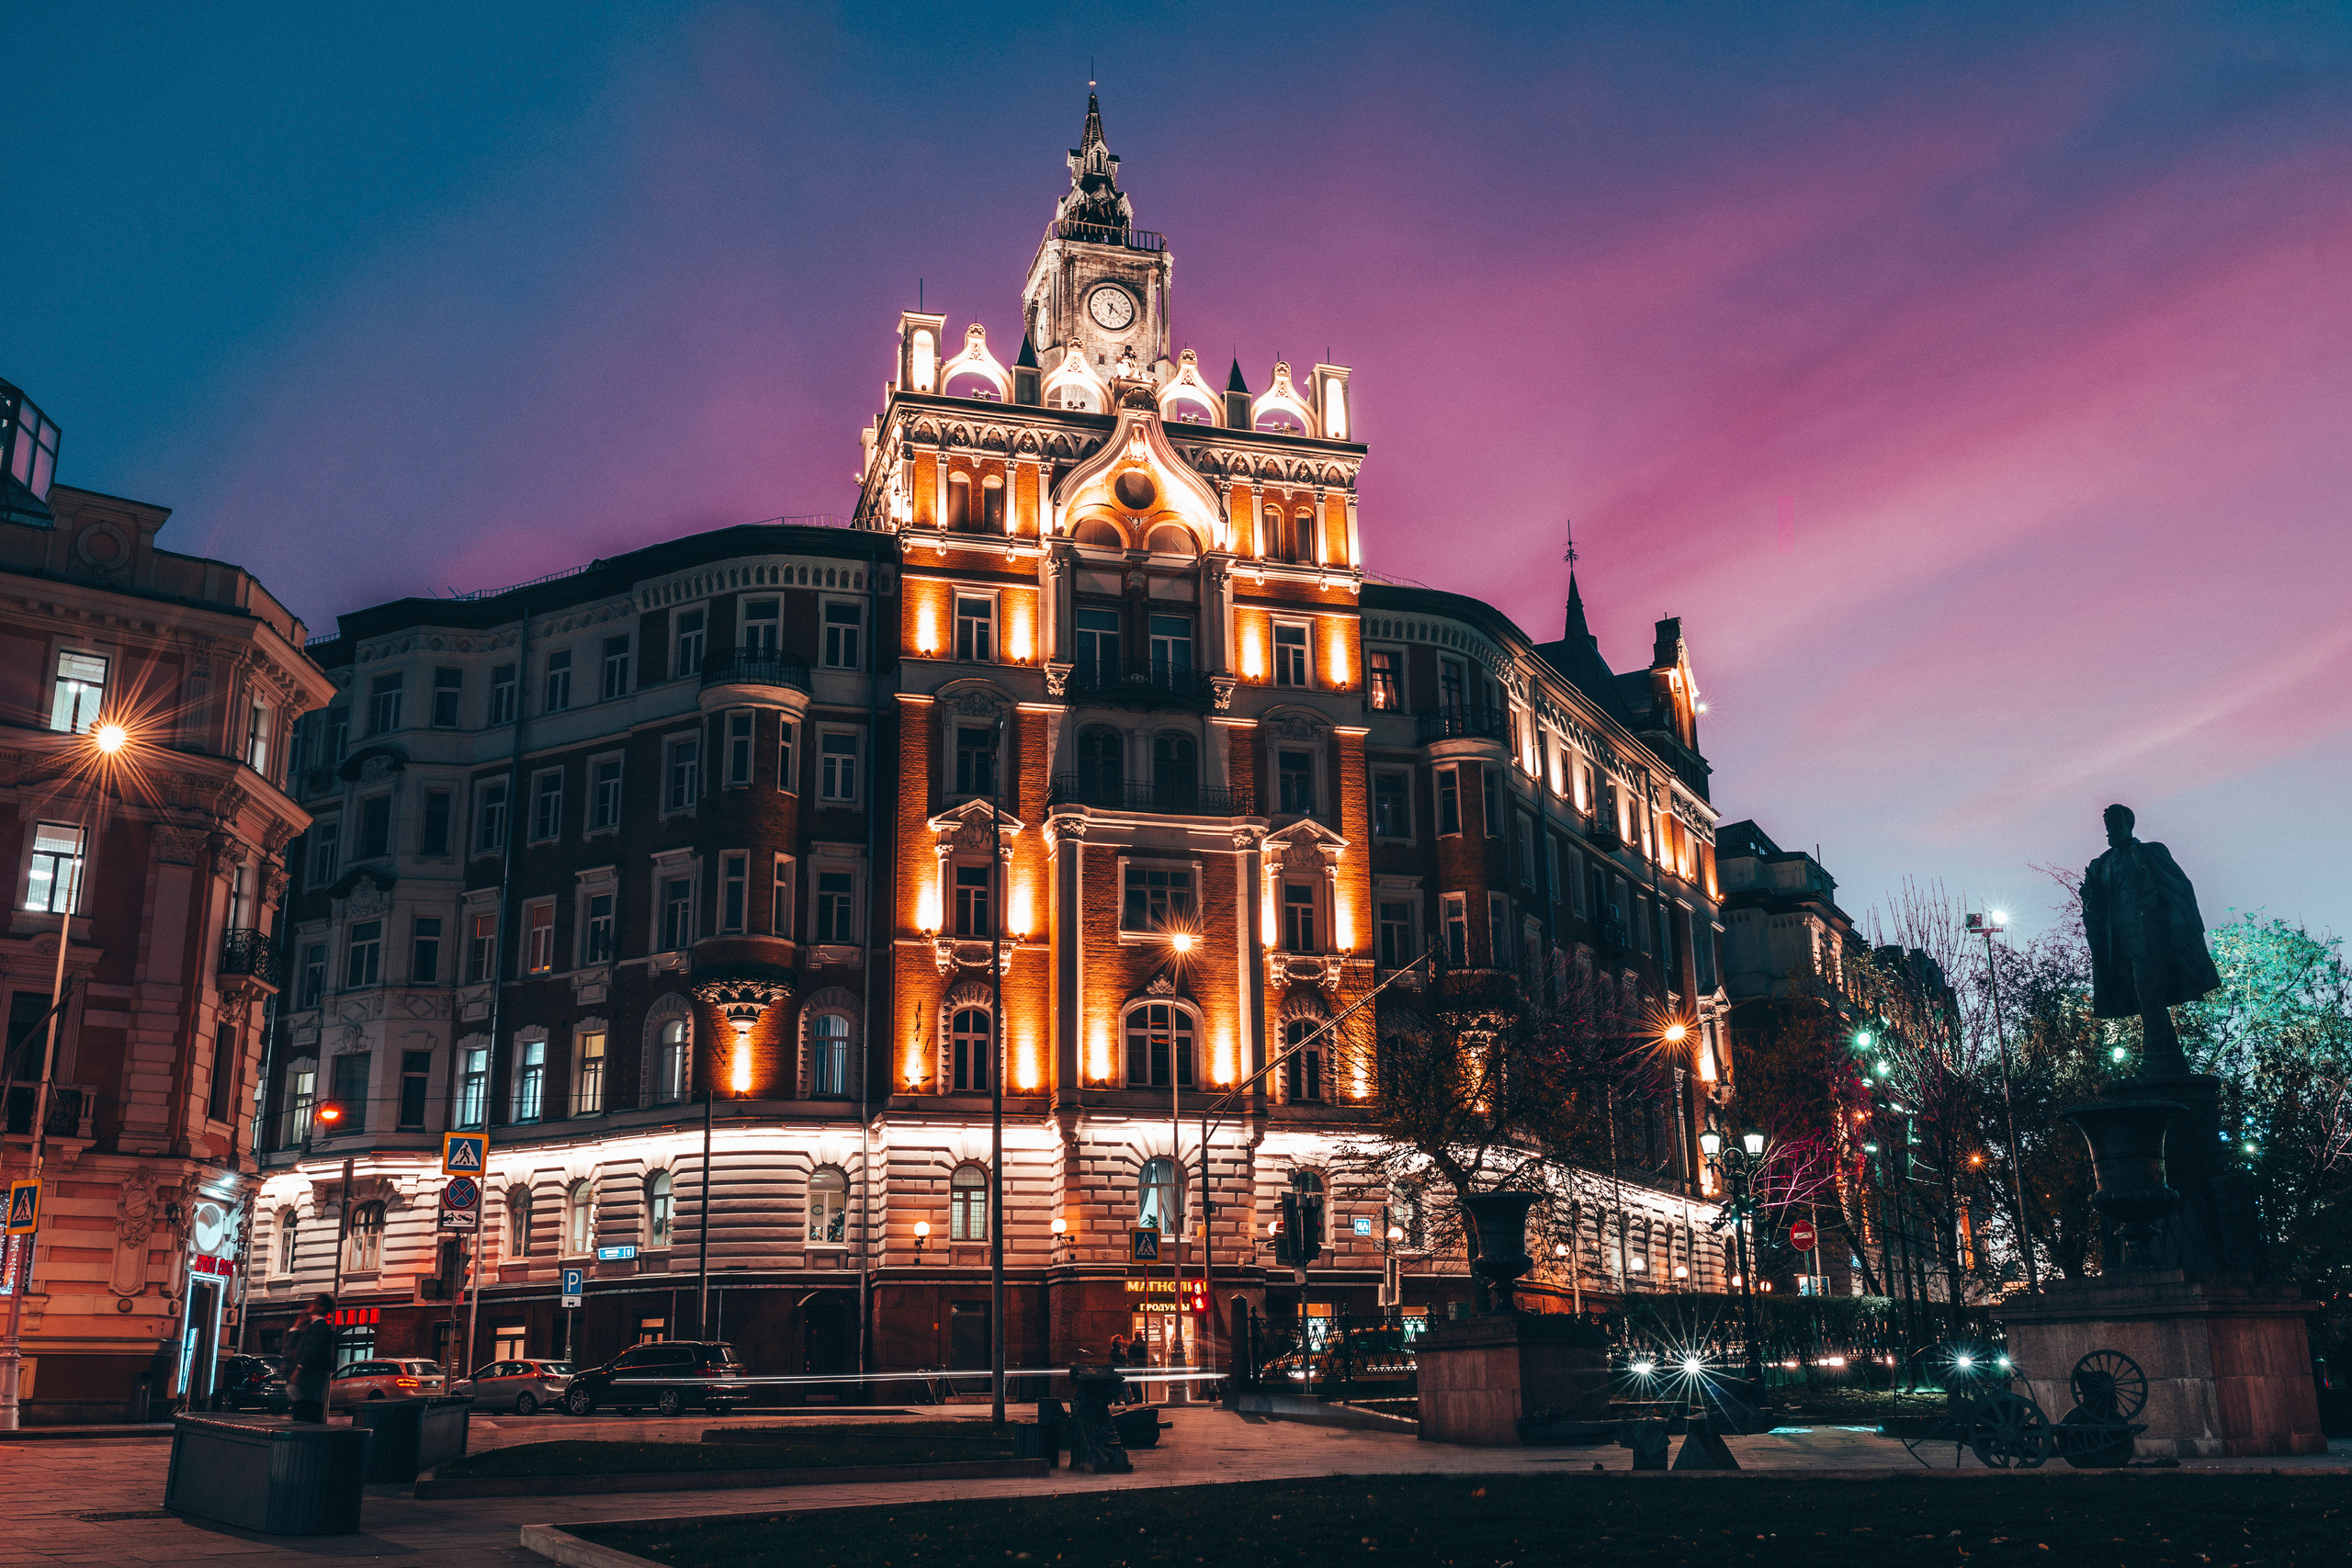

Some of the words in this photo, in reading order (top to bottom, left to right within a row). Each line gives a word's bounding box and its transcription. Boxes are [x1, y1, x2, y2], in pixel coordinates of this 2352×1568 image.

[568, 1271, 579, 1292] P
[1127, 1280, 1207, 1292] МАГНОЛ
[1139, 1303, 1191, 1312] ПРОДУКЫ
